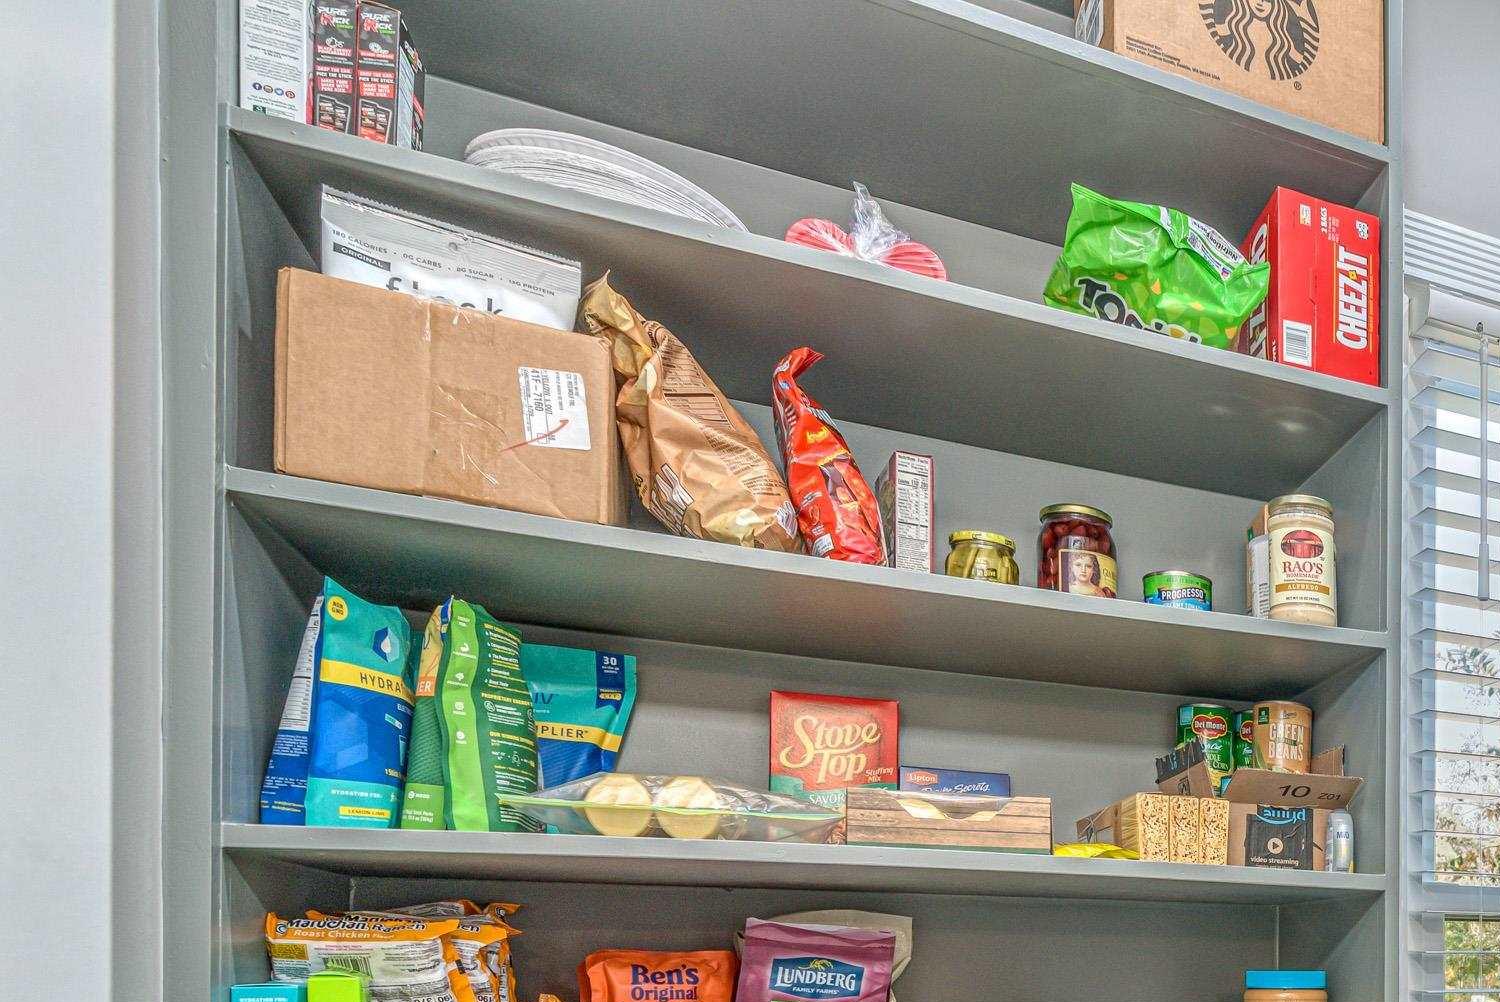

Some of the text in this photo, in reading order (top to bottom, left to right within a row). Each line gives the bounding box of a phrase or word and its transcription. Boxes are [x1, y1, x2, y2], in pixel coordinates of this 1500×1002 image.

[341, 246, 385, 269] ORIGINAL
[348, 235, 555, 296] CALORIES CARBS SUGAR PROTEIN
[1282, 561, 1323, 575] RAO'S
[1161, 588, 1204, 601] PROGRESSO
[603, 656, 617, 666] 30
[360, 672, 406, 694] HYDRA
[1193, 720, 1227, 732] Del Monte
[1269, 723, 1304, 741] GREEN
[779, 715, 881, 770] Stove
[1268, 742, 1304, 762] BEANS
[814, 747, 867, 785] Top
[909, 772, 936, 783] Lipton
[1279, 785, 1312, 798] 10
[809, 793, 846, 805] SAVOR
[1250, 856, 1300, 867] video streaming
[293, 929, 372, 939] Roast Chicken
[631, 964, 700, 986] Ben's
[775, 967, 857, 992] LUNDBERG
[792, 986, 815, 994] FAMILY
